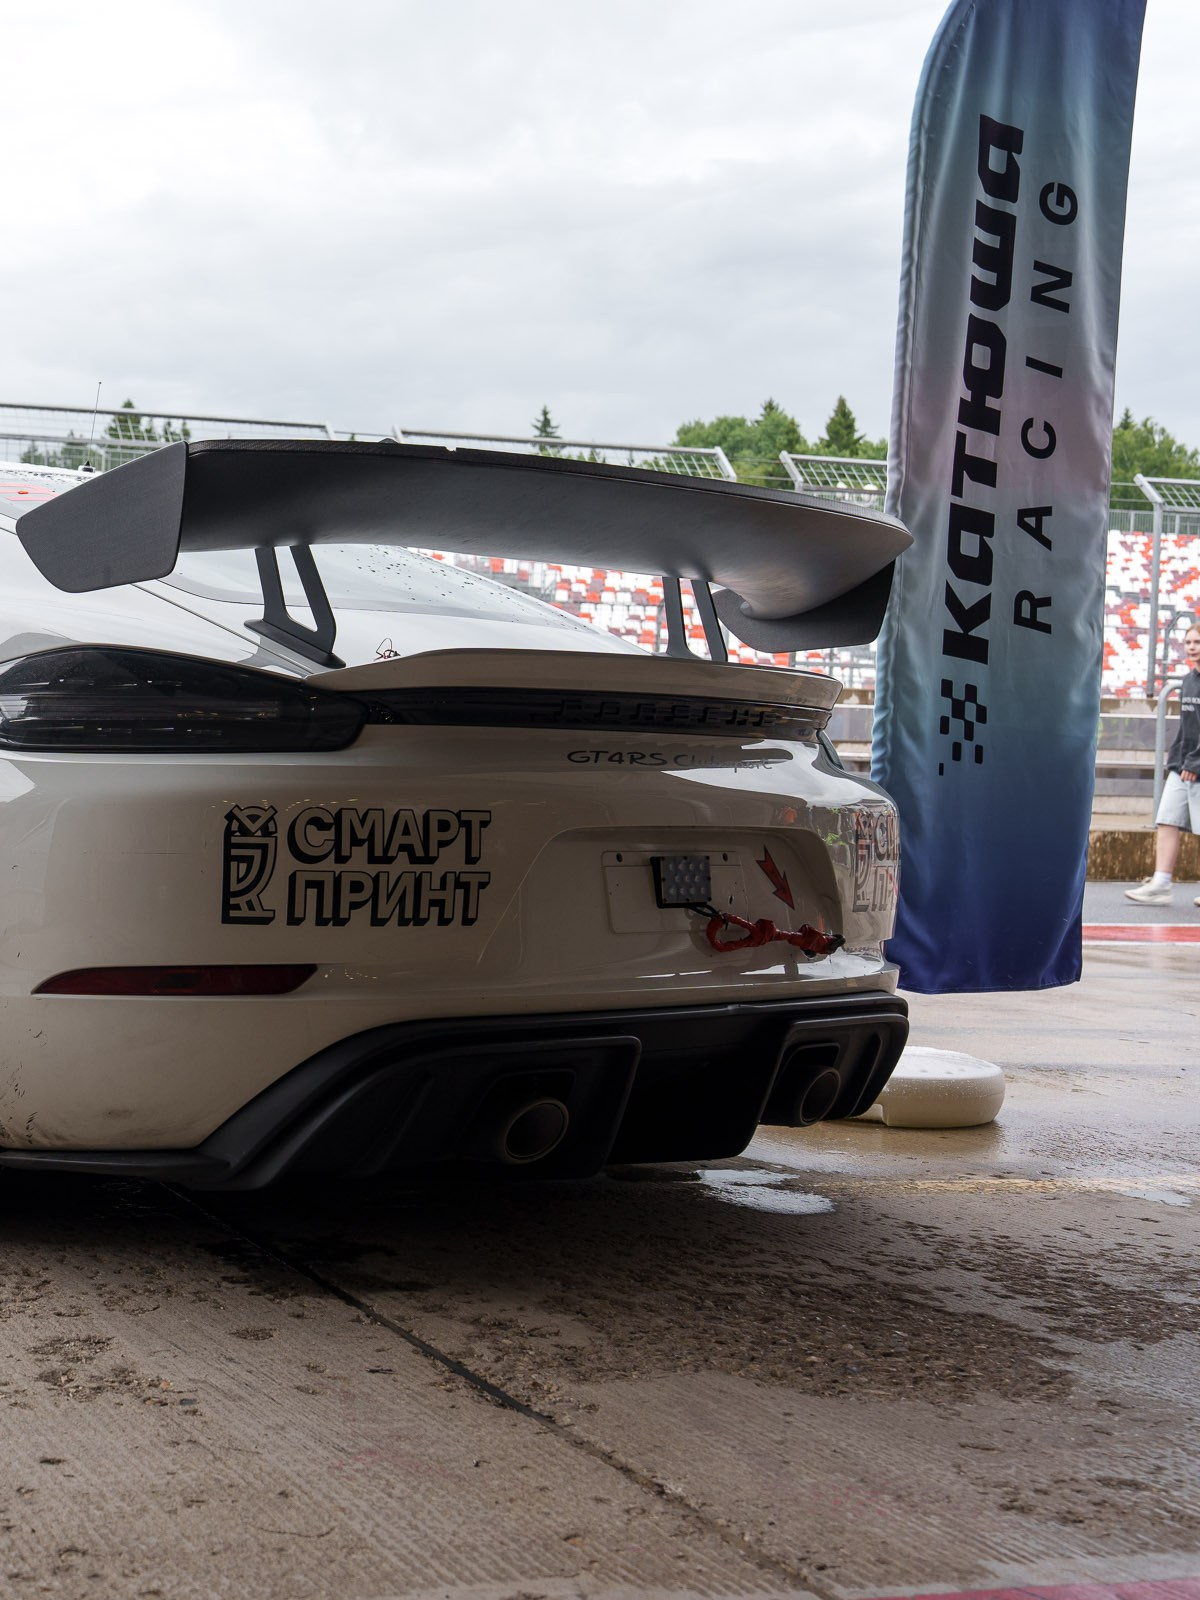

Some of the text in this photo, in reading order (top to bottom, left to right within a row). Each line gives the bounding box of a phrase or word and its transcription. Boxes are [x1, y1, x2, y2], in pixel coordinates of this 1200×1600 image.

[1013, 181, 1078, 635] RACING
[287, 806, 492, 865] СМАРТ
[286, 870, 491, 927] ПРИНТ
